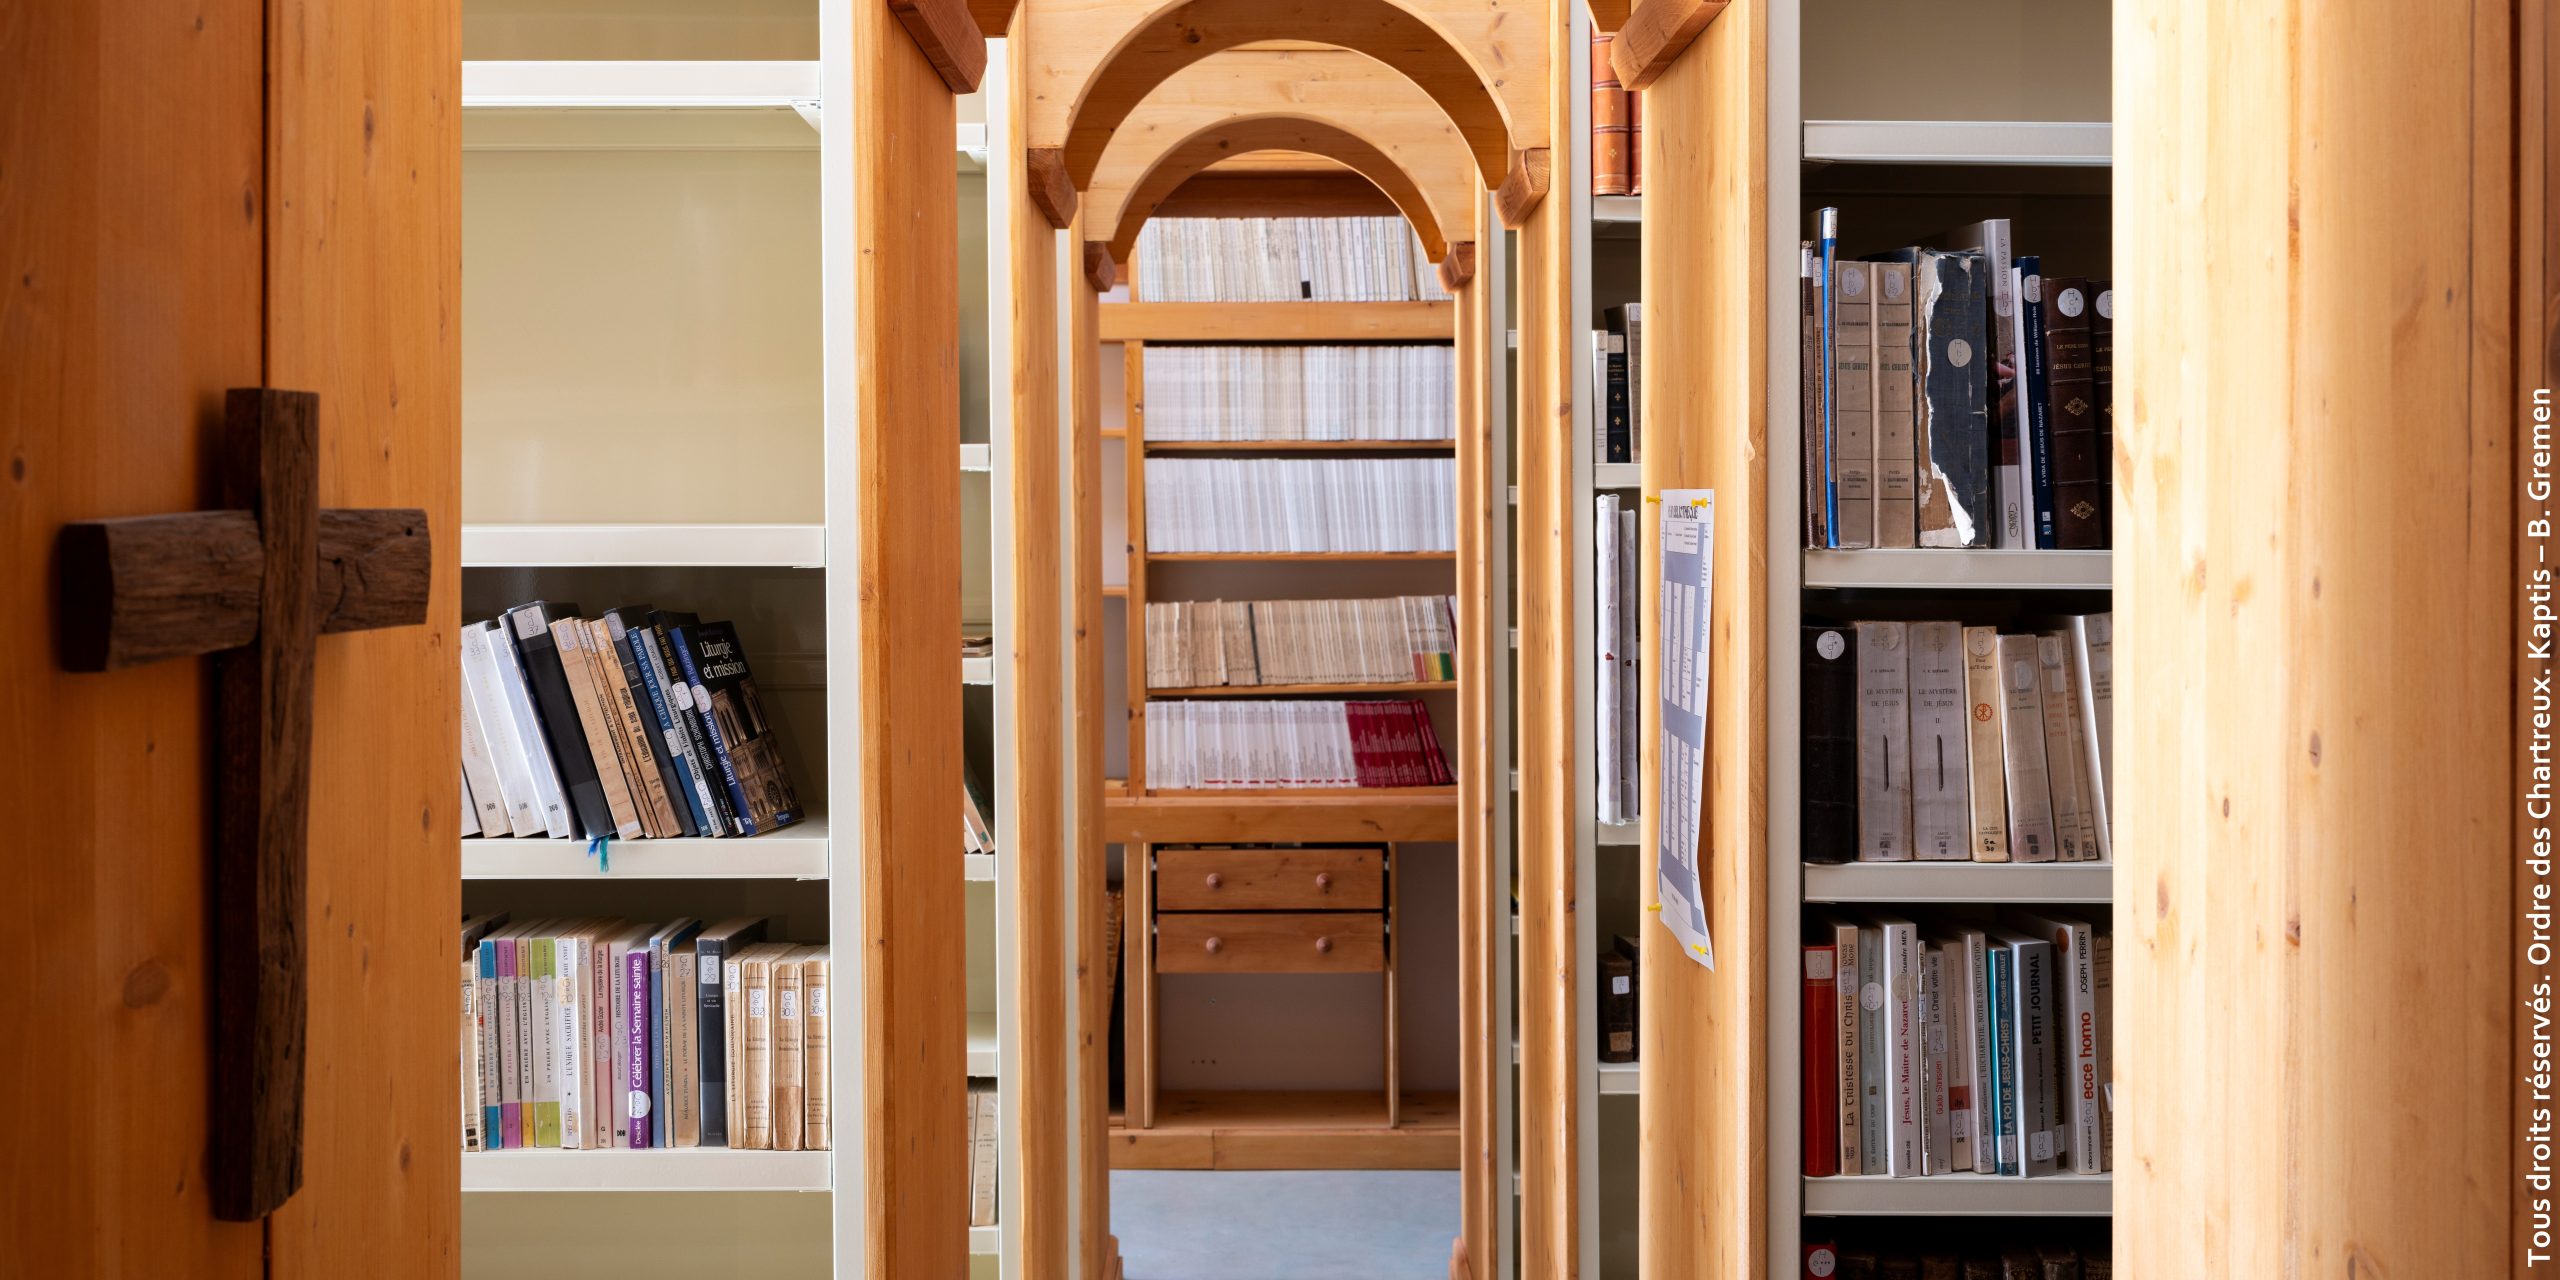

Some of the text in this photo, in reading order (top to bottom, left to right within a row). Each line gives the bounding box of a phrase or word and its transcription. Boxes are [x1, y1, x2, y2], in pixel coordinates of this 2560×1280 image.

[631, 632, 647, 661] PAROLE
[700, 638, 733, 659] Liturgie
[640, 660, 650, 670] SA
[704, 658, 746, 679] et mission
[644, 671, 657, 688] JOUR
[652, 690, 667, 721] CHAQUE
[665, 689, 680, 724] Liturgiques
[703, 712, 736, 786] Liturgie et mission
[691, 759, 700, 780] Objets
[707, 957, 714, 965] G
[1974, 942, 1983, 997] SANCTIFICATION
[705, 974, 716, 982] 29
[752, 991, 760, 999] G
[784, 992, 791, 1000] G
[813, 989, 820, 998] G
[2030, 953, 2042, 1044] PETIT JOURNAL
[632, 991, 641, 1034] Semaine
[1933, 1014, 1939, 1023] Le
[632, 1036, 641, 1044] la
[1844, 994, 1855, 1126] La Tristesse du Chris
[2080, 1012, 2094, 1099] ecce homo
[632, 1046, 642, 1088] Célébrer
[1900, 1040, 1912, 1125] Jésus, le Maître de
[2002, 1087, 2011, 1100] DE
[1935, 1095, 1943, 1114] Guido
[2002, 1103, 2011, 1119] FOI
[2002, 1121, 2012, 1134] LA
